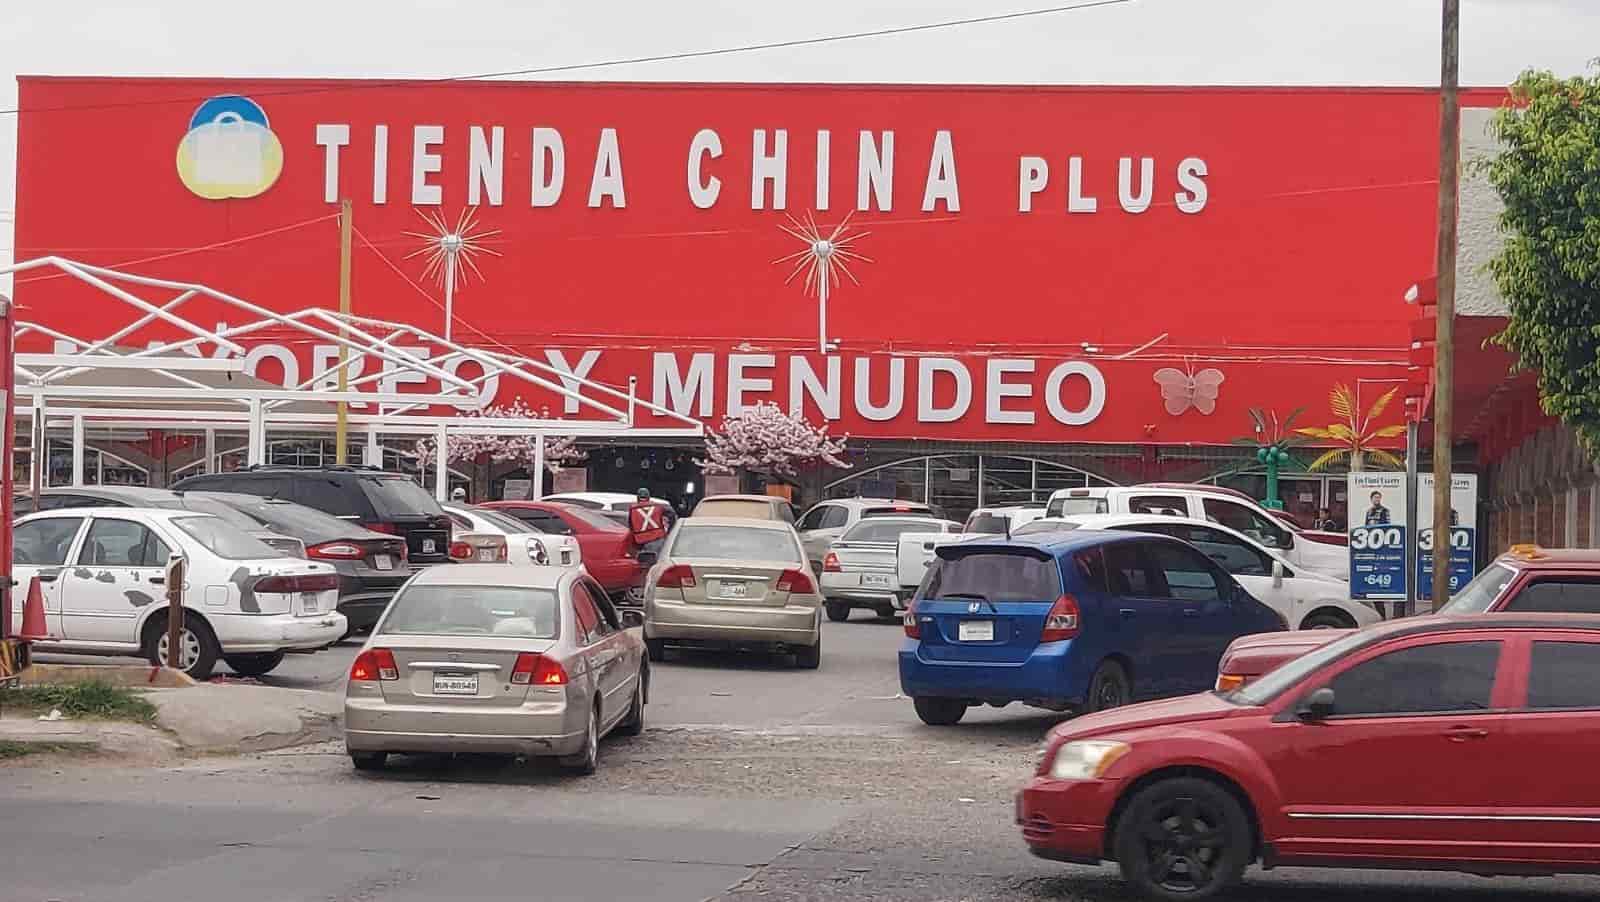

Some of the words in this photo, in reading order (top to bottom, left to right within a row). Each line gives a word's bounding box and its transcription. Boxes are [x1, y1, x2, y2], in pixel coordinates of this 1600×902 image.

[316, 124, 626, 208] TIENDA
[687, 128, 961, 212] CHINA
[1018, 156, 1209, 214] PLUS
[544, 348, 602, 414] Y
[652, 351, 1107, 426] MENUDEO
